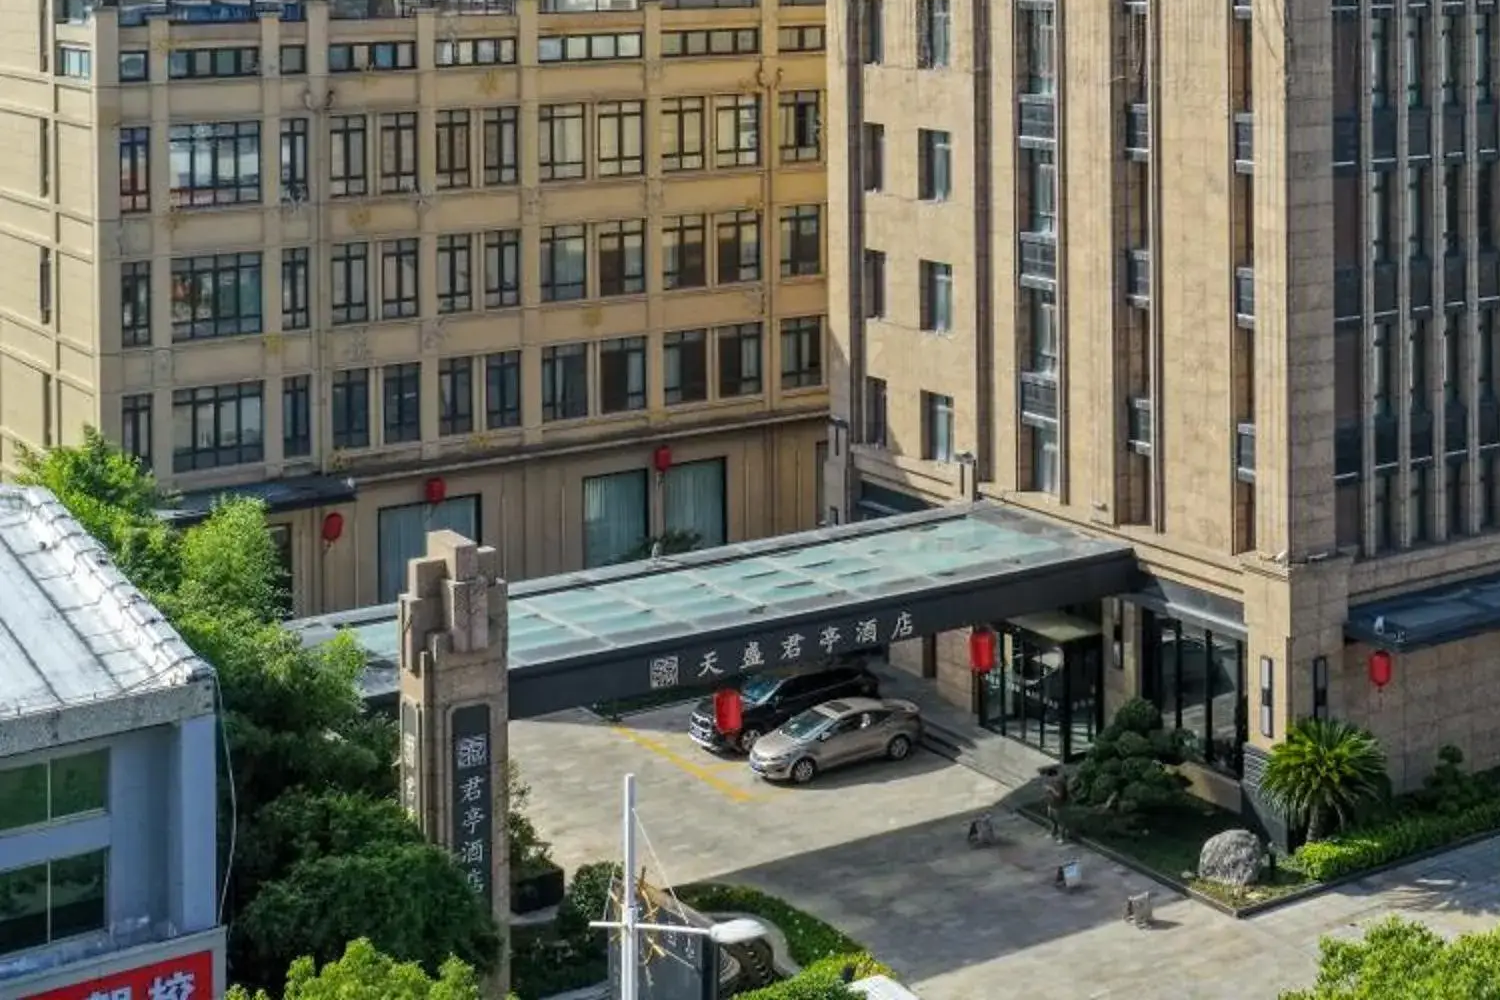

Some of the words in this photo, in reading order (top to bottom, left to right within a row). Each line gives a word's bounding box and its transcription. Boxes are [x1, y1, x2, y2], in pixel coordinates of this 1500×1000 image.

[698, 611, 914, 678] 天盛君亭酒店
[459, 775, 486, 894] 君亭酒店
